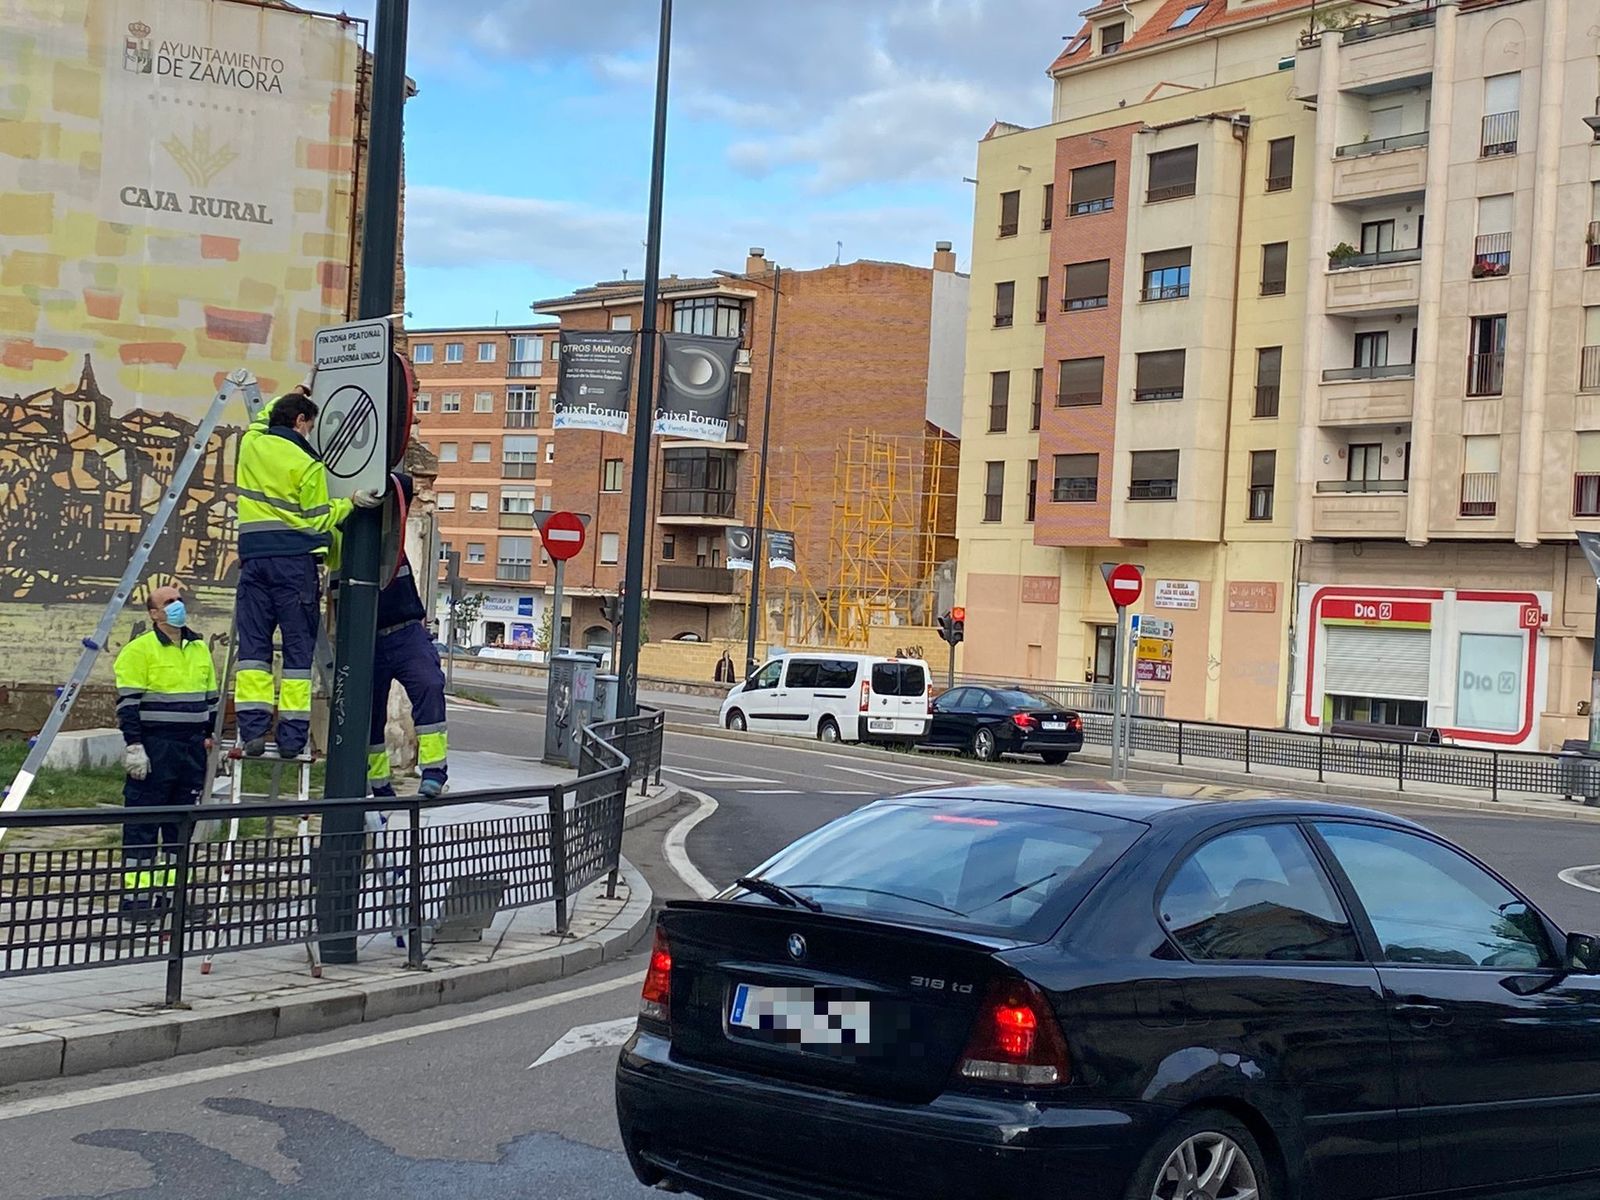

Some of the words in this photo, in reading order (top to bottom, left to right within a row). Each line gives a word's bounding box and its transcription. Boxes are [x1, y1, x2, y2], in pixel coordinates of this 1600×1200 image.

[158, 40, 284, 74] AYUNTAMIENTO
[156, 56, 183, 78] DE
[189, 61, 283, 94] ZAMORA
[119, 186, 182, 212] CAJA
[189, 195, 273, 225] RURAL
[318, 336, 329, 344] FIN
[329, 334, 347, 343] ZONA
[348, 330, 381, 340] PEATONAL
[348, 343, 357, 351] DE
[562, 344, 591, 353] OTROS
[592, 344, 633, 355] MUNDOS
[318, 354, 360, 365] PLATAFORMA
[553, 402, 629, 419] CaixaForum
[654, 407, 728, 428] CaixaForum
[325, 411, 370, 450] 20
[910, 976, 945, 989] 318
[952, 982, 974, 994] td
